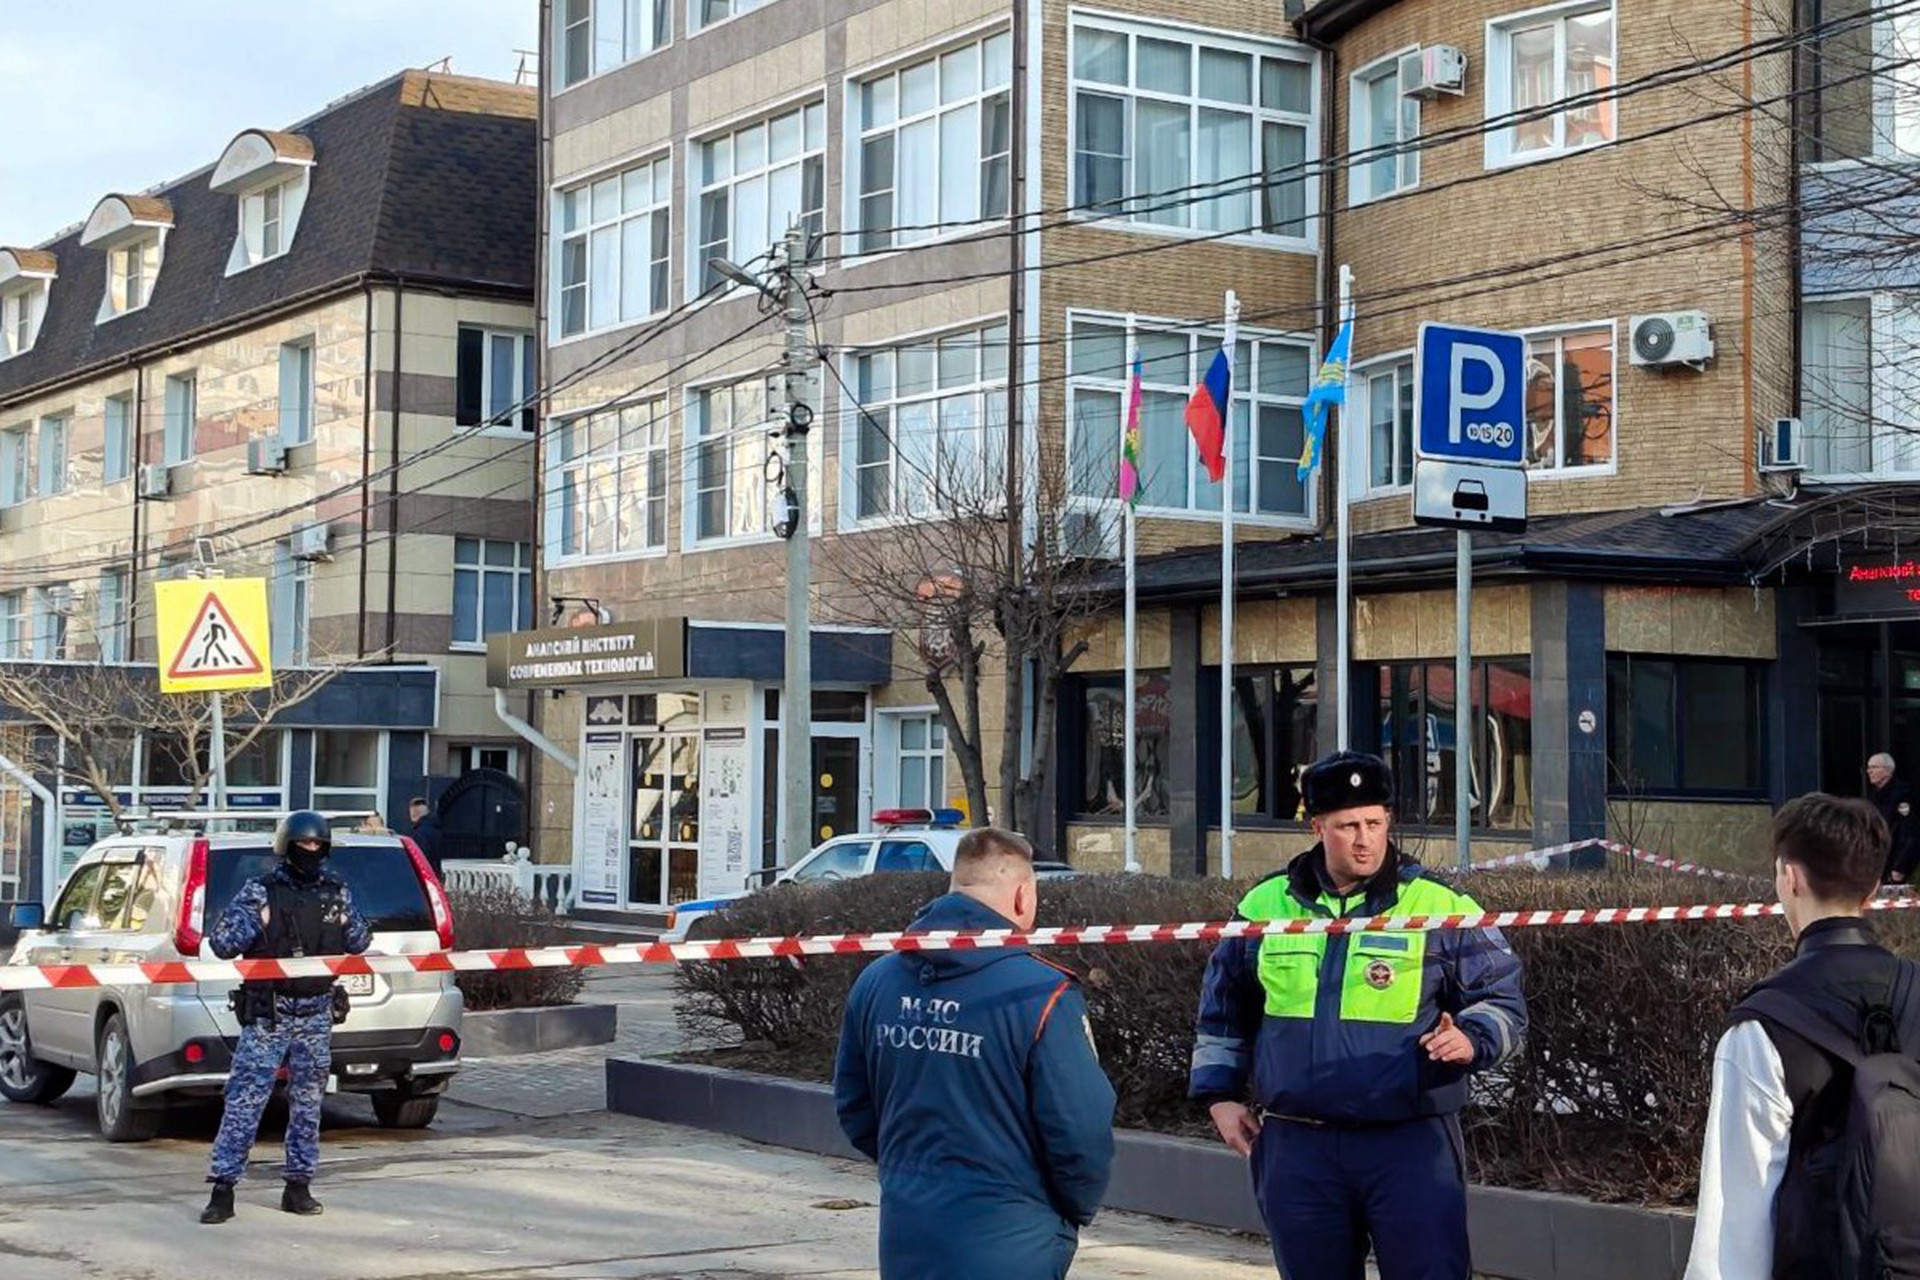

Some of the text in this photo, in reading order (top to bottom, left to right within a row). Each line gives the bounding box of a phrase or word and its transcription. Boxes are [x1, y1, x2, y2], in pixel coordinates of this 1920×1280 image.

[1448, 342, 1505, 443] P
[1482, 426, 1492, 439] 15
[1496, 426, 1512, 442] 20
[525, 634, 635, 658] АНАПСКИЙ ИНСТИТУТ
[510, 651, 654, 679] СОВРЕМЕННЫХ ТЕХНОЛОГИЙ
[351, 975, 367, 988] 23
[899, 996, 960, 1024] МЧС
[877, 1024, 984, 1059] РОССИИ
